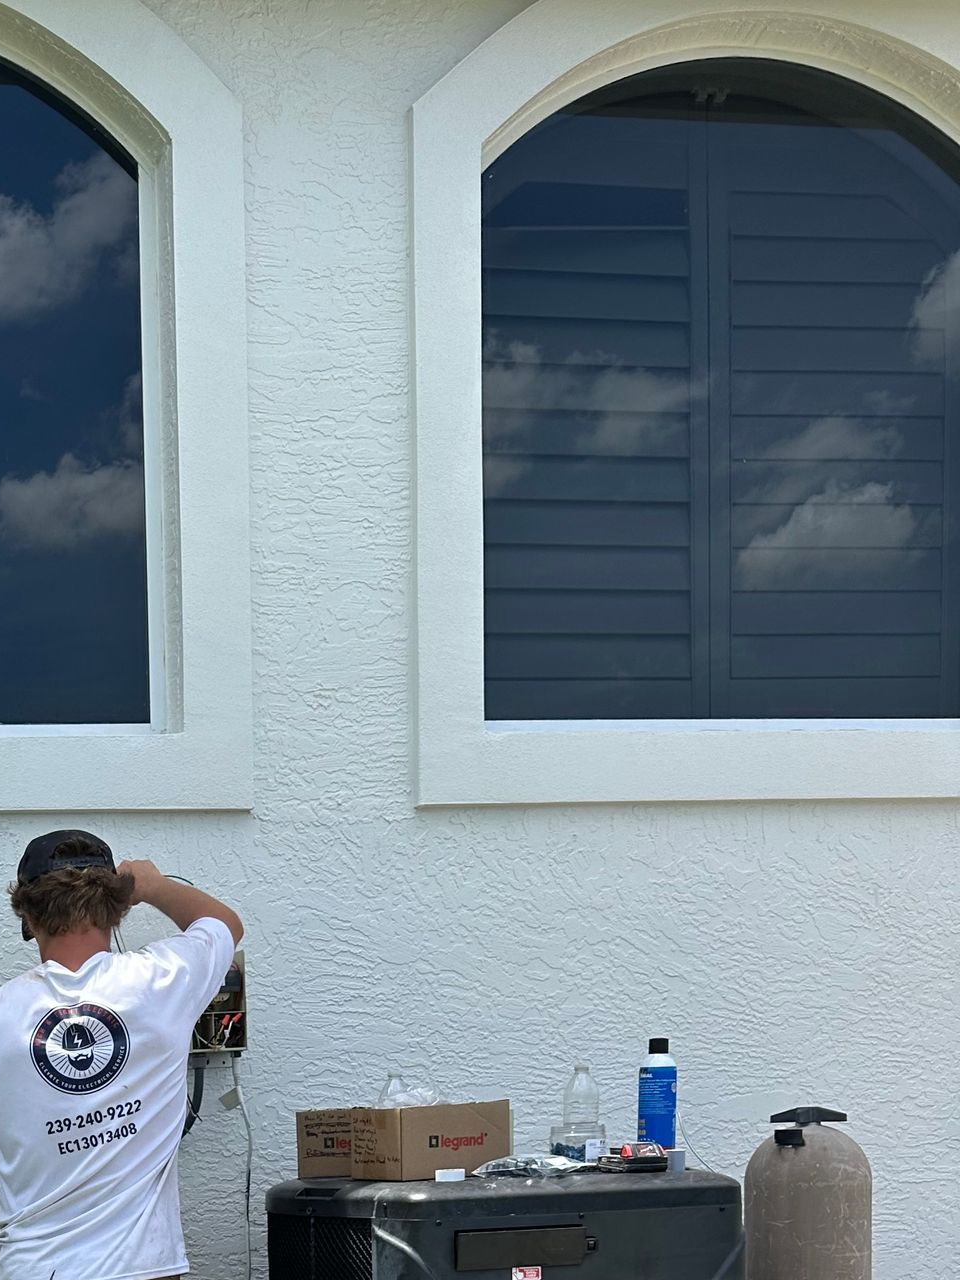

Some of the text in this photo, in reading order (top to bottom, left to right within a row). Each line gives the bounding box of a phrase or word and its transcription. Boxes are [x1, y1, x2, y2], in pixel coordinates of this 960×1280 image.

[82, 1004, 120, 1028] ELECTRIC
[40, 1046, 125, 1090] ELEVATE YOUR ELECTRICAL SERVICE
[45, 1099, 142, 1135] 239-240-9222
[57, 1122, 138, 1155] EC13013408
[440, 1132, 484, 1151] legrand
